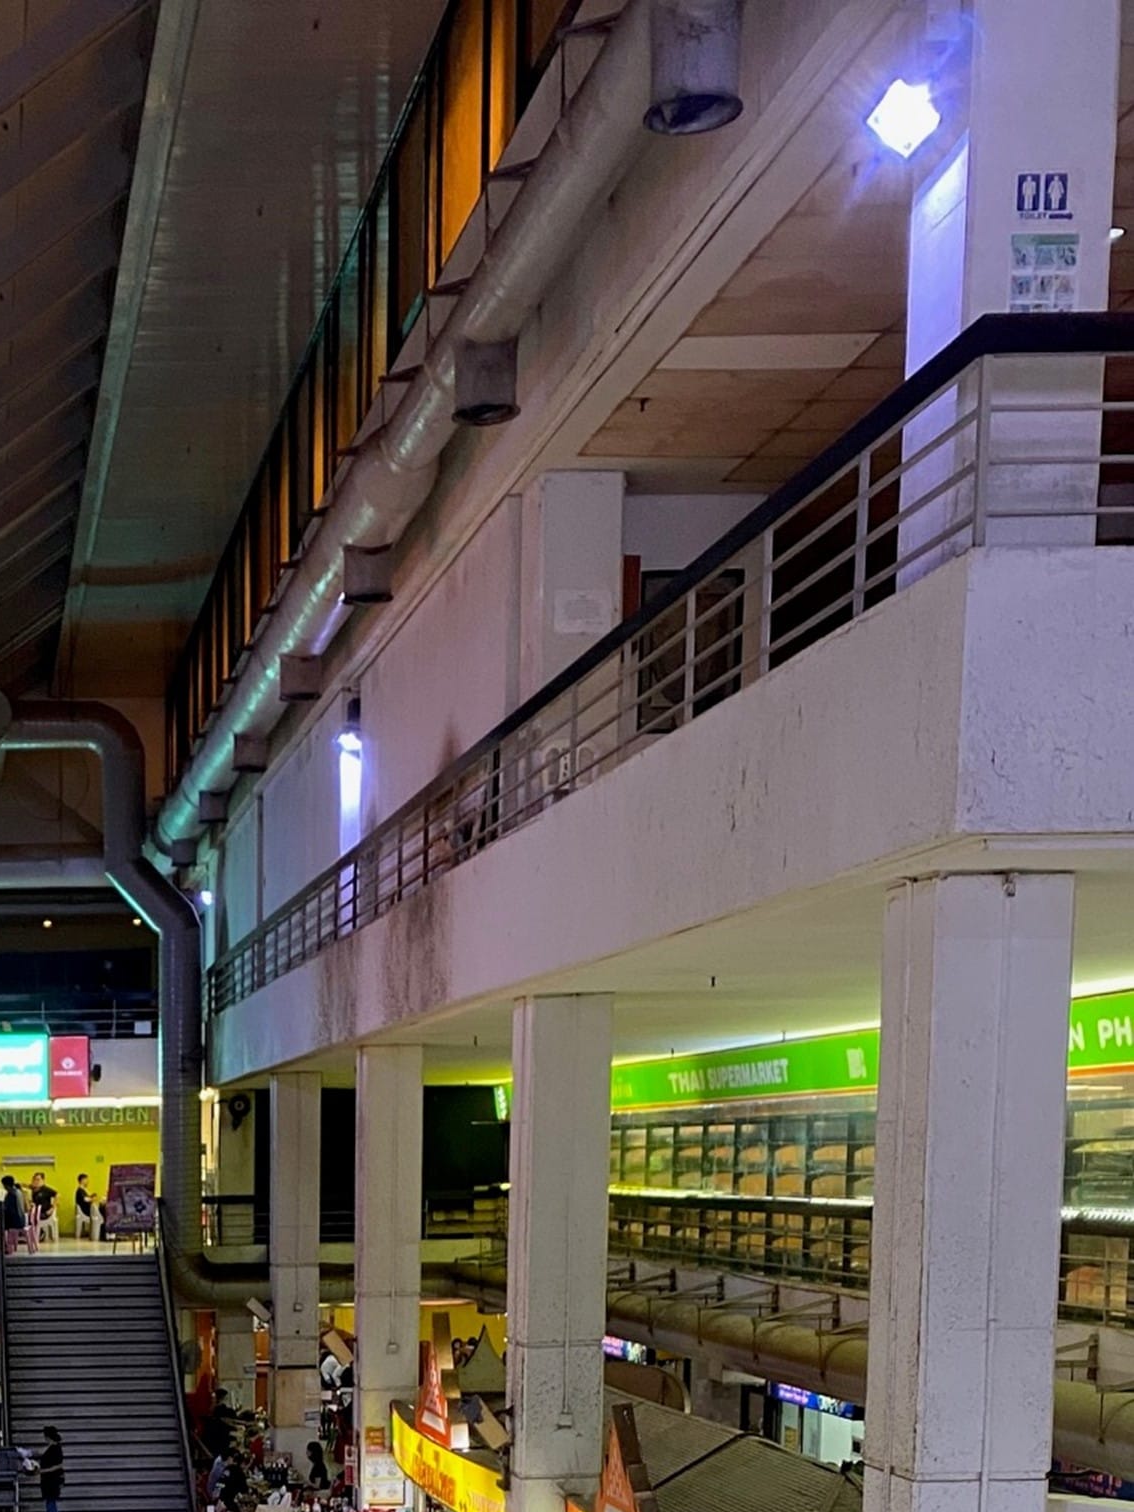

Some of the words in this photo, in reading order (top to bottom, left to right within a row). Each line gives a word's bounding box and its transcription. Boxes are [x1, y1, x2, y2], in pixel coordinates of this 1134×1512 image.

[667, 1069, 706, 1094] THAI
[707, 1058, 789, 1090] SUPERMARKET
[68, 1107, 150, 1123] KITCHEN
